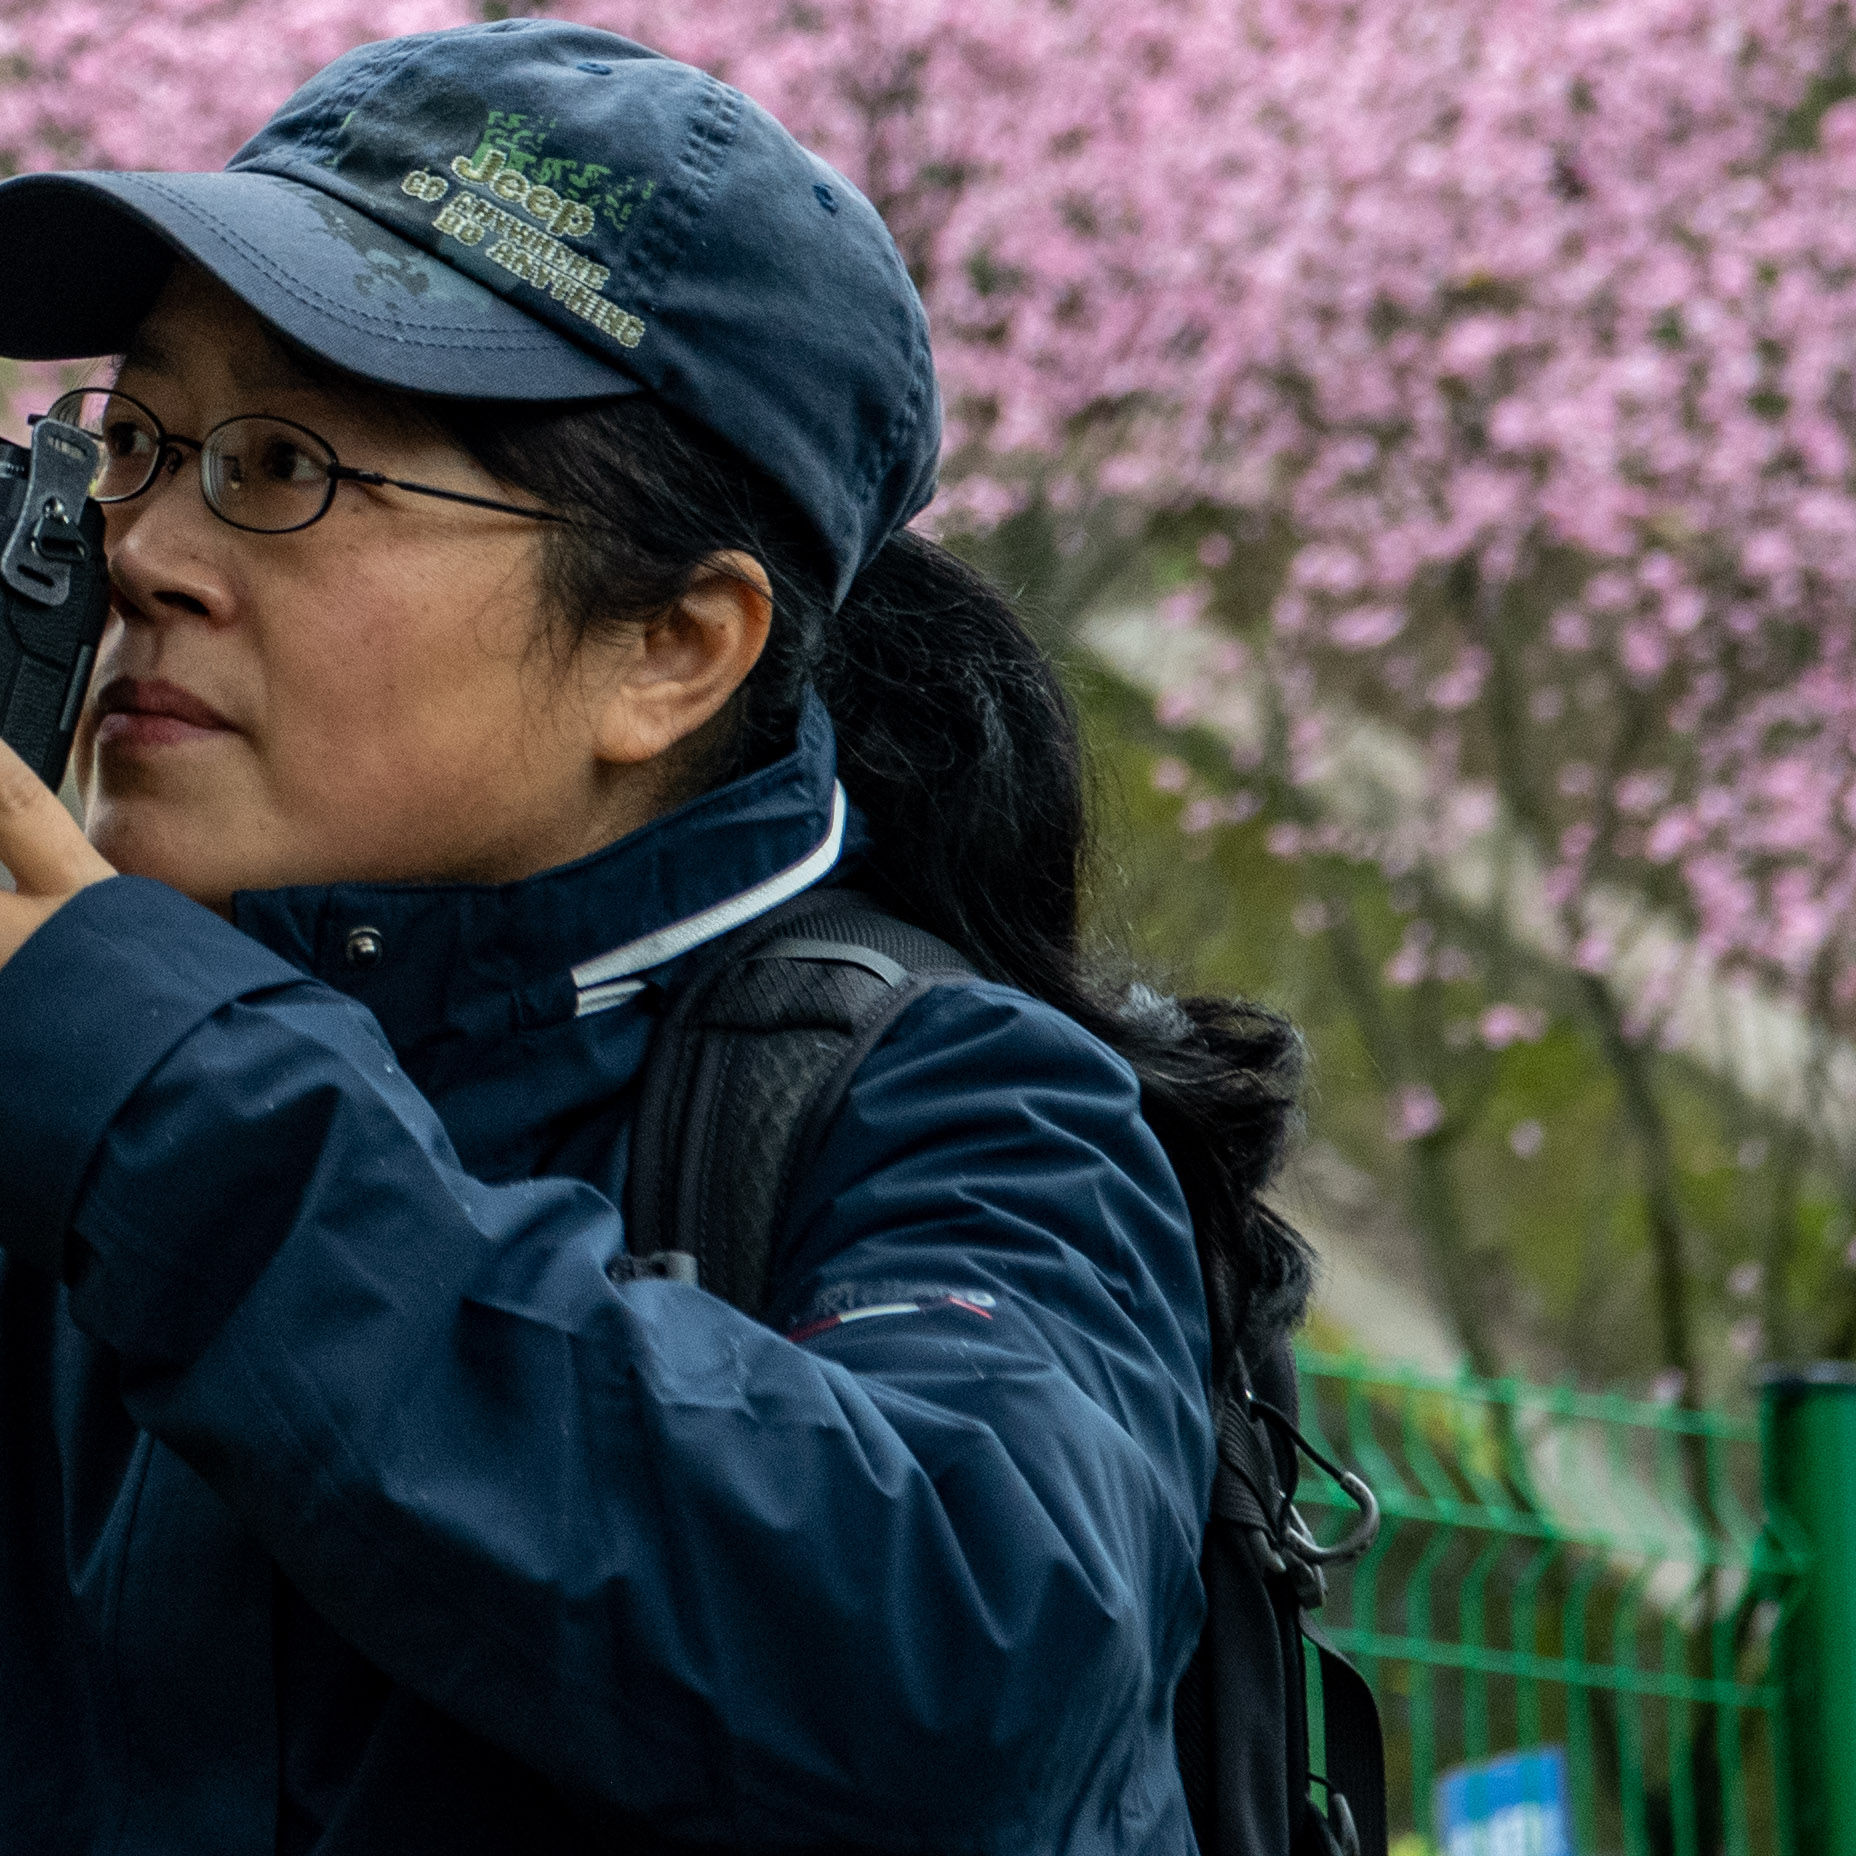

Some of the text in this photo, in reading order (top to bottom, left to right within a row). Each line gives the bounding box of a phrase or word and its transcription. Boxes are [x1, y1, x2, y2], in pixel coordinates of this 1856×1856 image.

[401, 170, 611, 290] GO ANYWHERE
[451, 149, 595, 237] Jeep
[432, 207, 645, 348] DO ANYTHING
